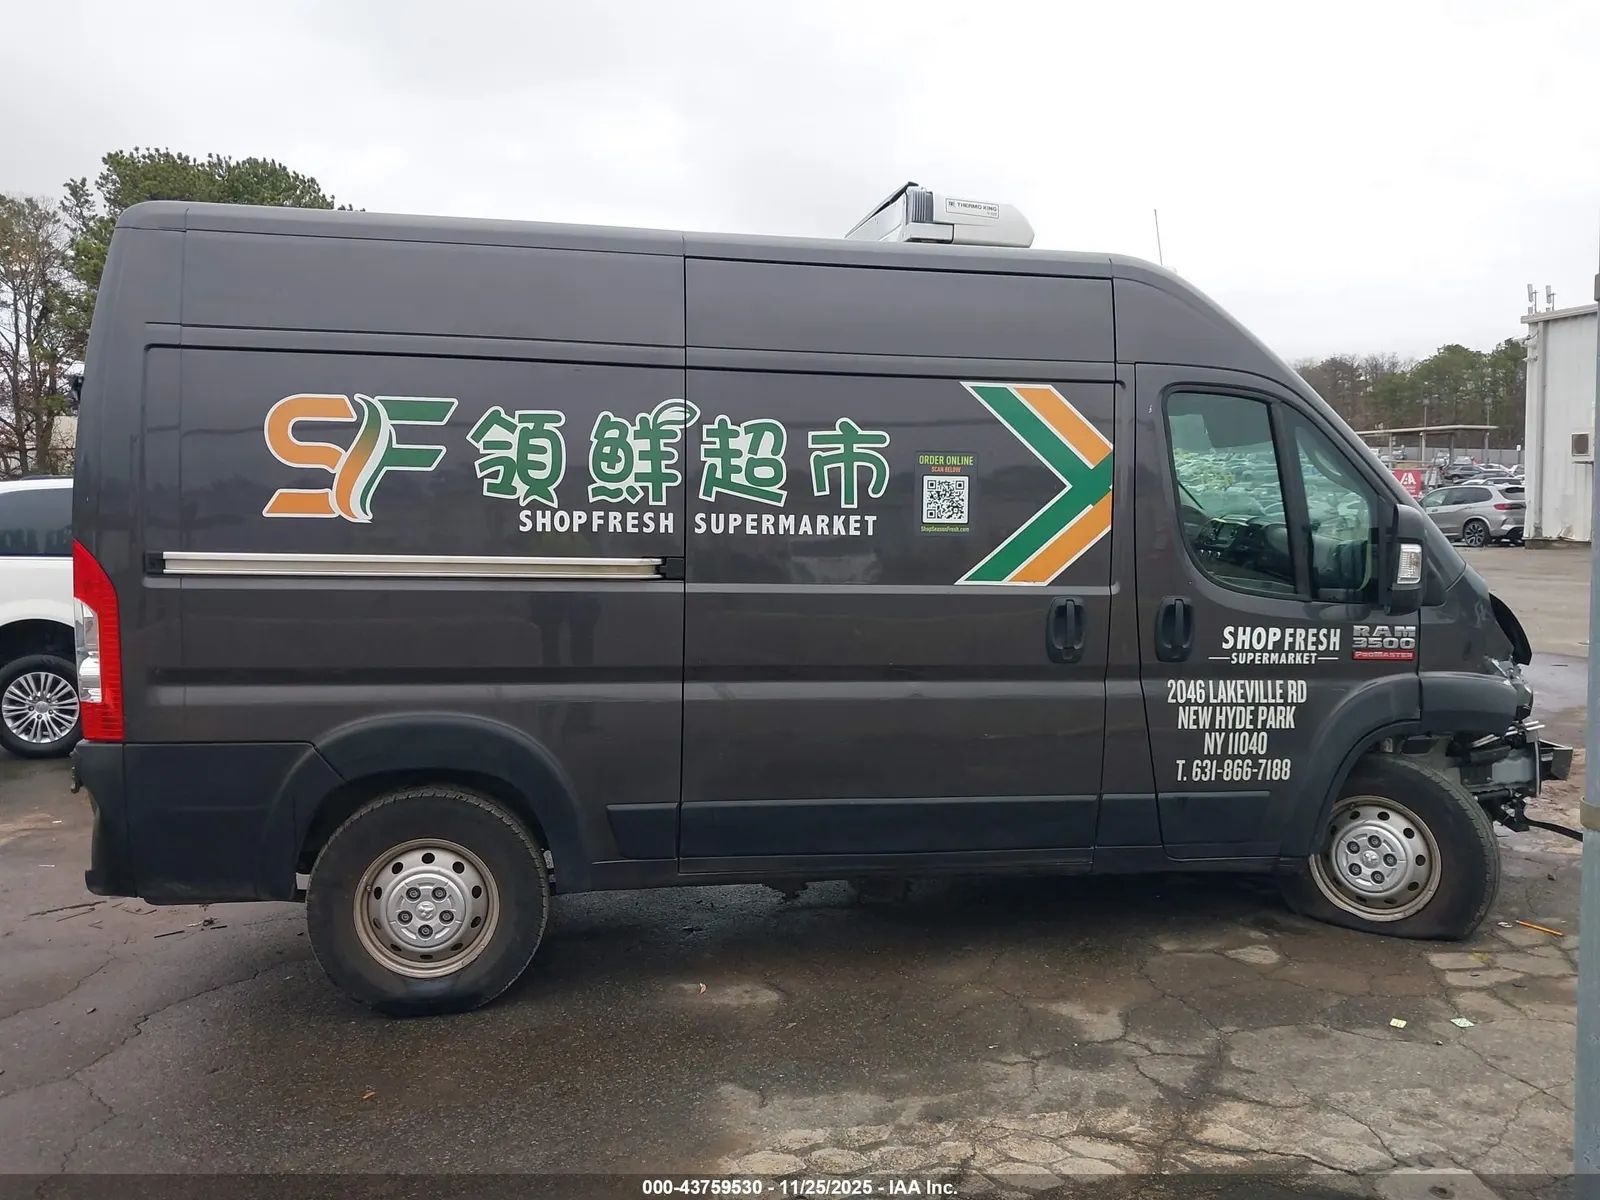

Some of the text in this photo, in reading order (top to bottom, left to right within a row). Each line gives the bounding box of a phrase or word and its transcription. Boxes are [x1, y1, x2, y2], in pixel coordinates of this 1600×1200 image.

[957, 202, 983, 210] THERMO
[466, 399, 891, 510] 領鮮超市
[919, 455, 974, 466] ORDER ONLINE
[694, 513, 877, 537] SUPERMARKET
[1353, 625, 1416, 637] RAM
[1352, 637, 1416, 650] 3500
[1231, 652, 1317, 664] SUPERMARKET
[1167, 679, 1307, 704] 2046 LAKEVILLE RD
[1178, 706, 1296, 729] NEW HYDE PARK
[1204, 731, 1267, 755] NY 11040
[1176, 759, 1291, 781] T. 631-866-7188
